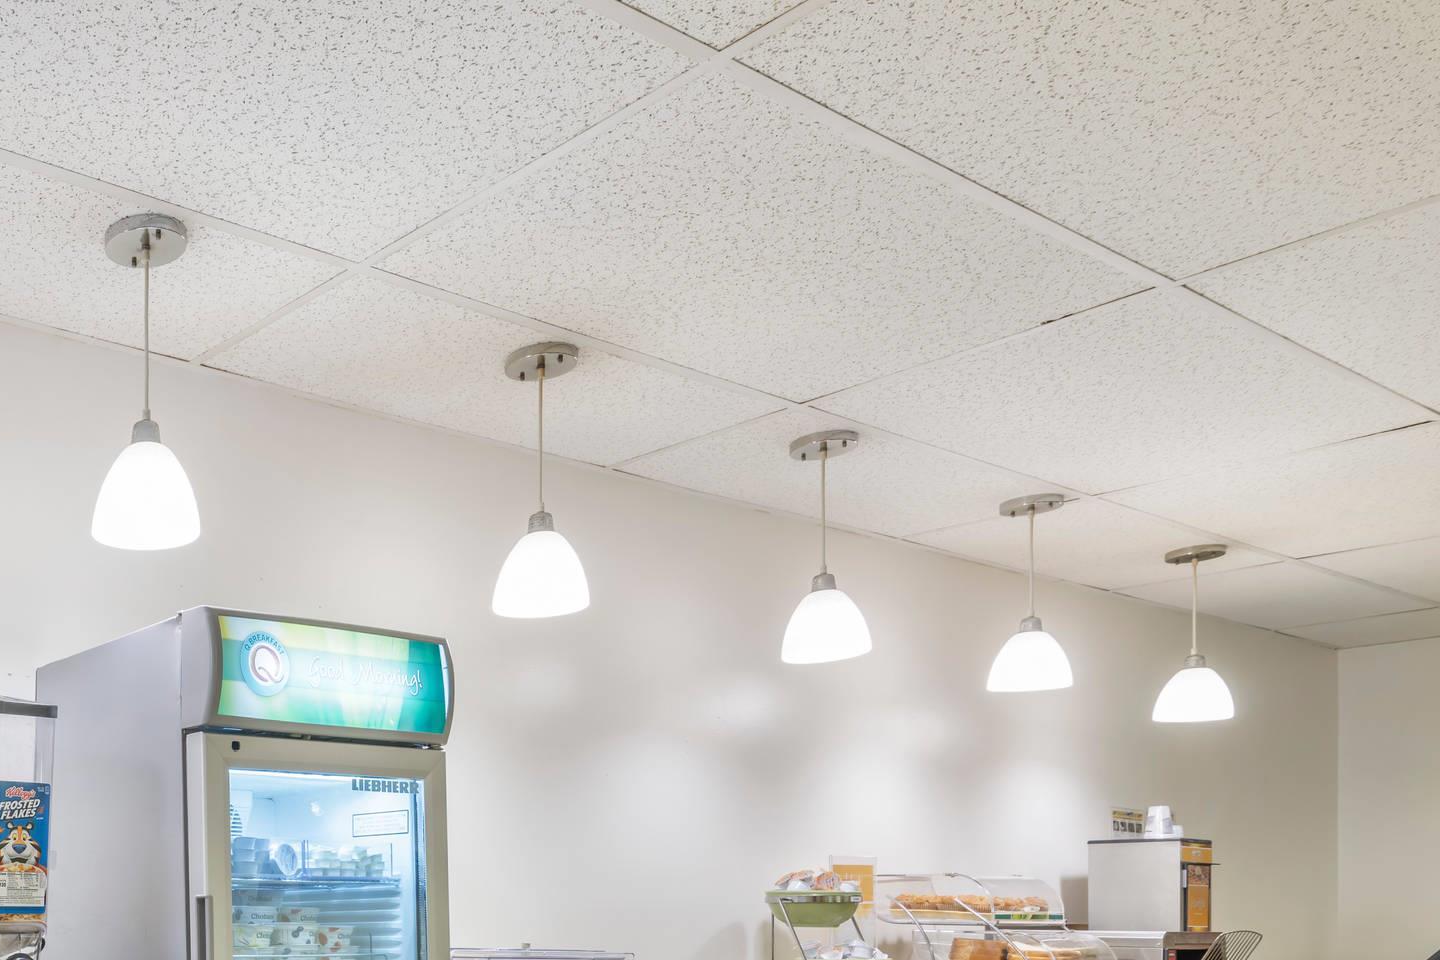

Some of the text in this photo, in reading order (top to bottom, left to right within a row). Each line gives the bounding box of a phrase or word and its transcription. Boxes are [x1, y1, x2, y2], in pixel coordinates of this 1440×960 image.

[308, 656, 423, 696] Good Morning!
[5, 786, 36, 800] Kellogg's
[351, 778, 420, 794] LIEBHERR
[0, 808, 36, 820] FLAKES
